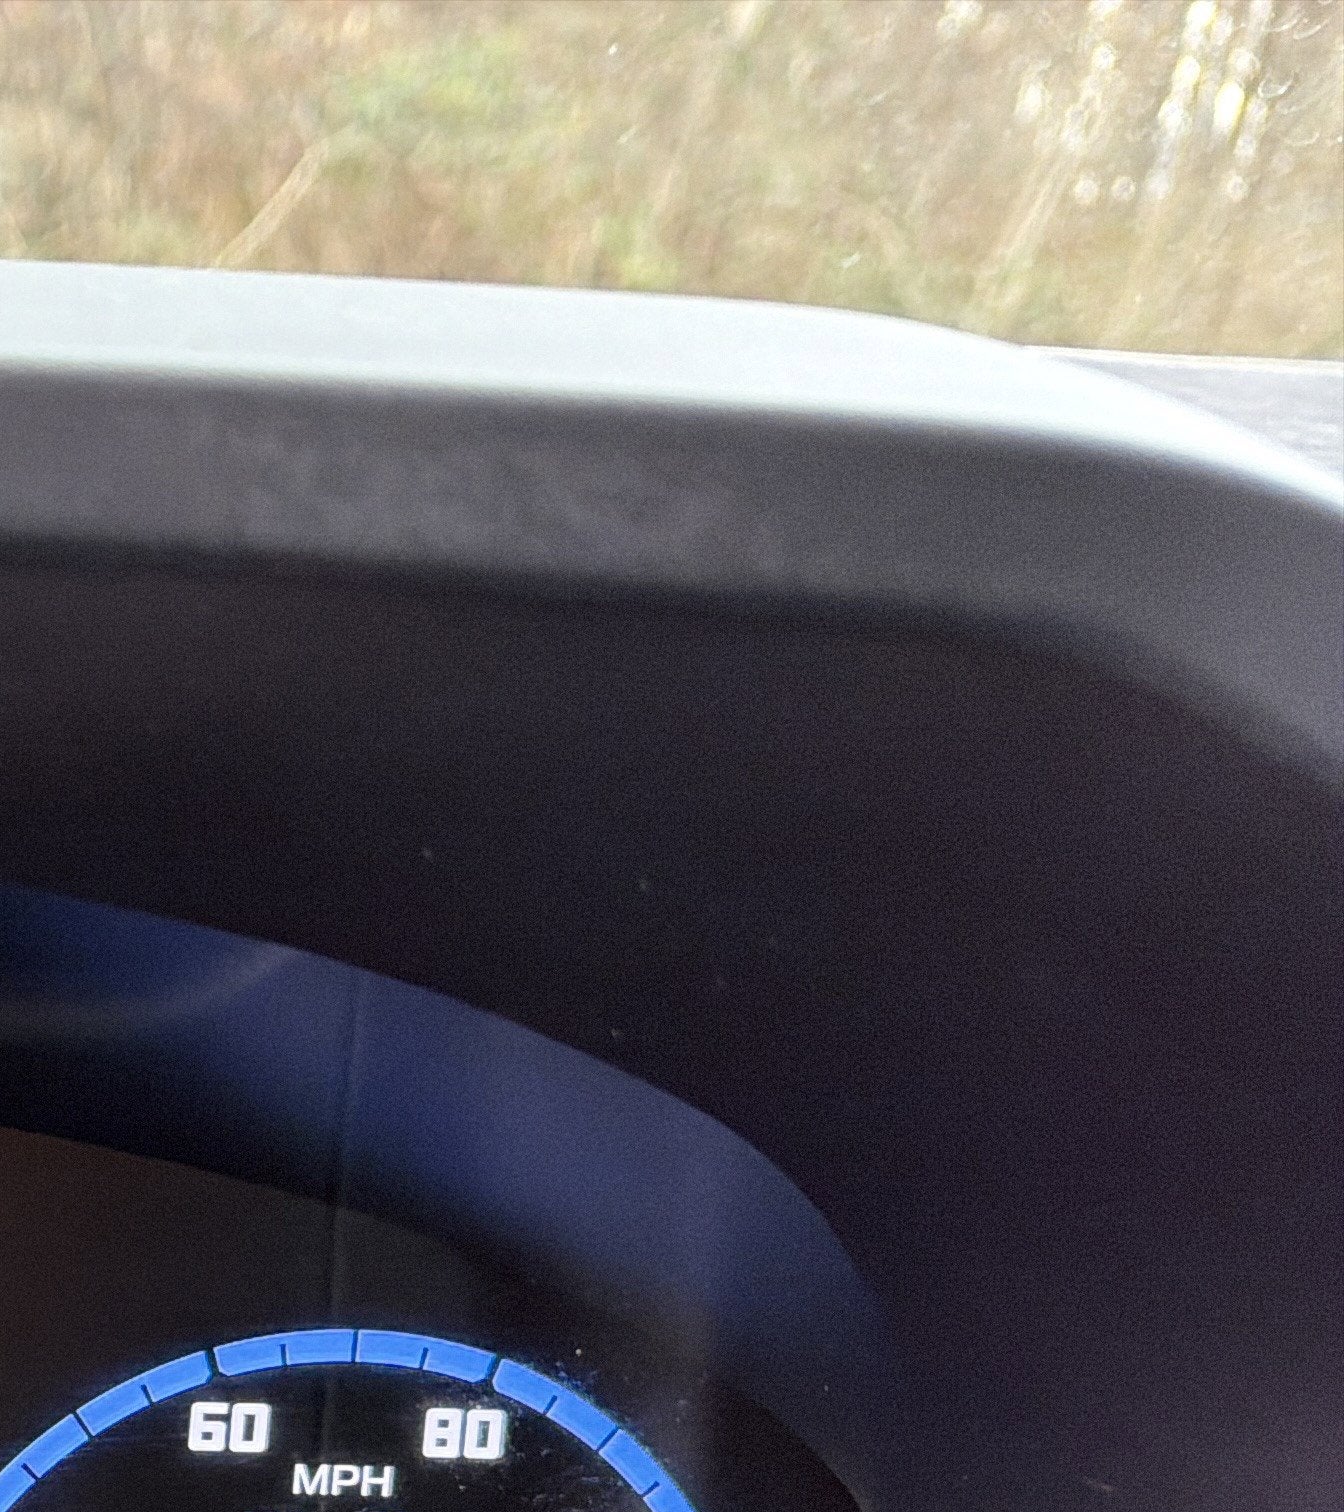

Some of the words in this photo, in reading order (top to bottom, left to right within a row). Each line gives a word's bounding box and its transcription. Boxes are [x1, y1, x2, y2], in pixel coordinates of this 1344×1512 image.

[188, 1402, 271, 1453] 60
[422, 1405, 507, 1459] 80
[293, 1464, 394, 1497] MPH
